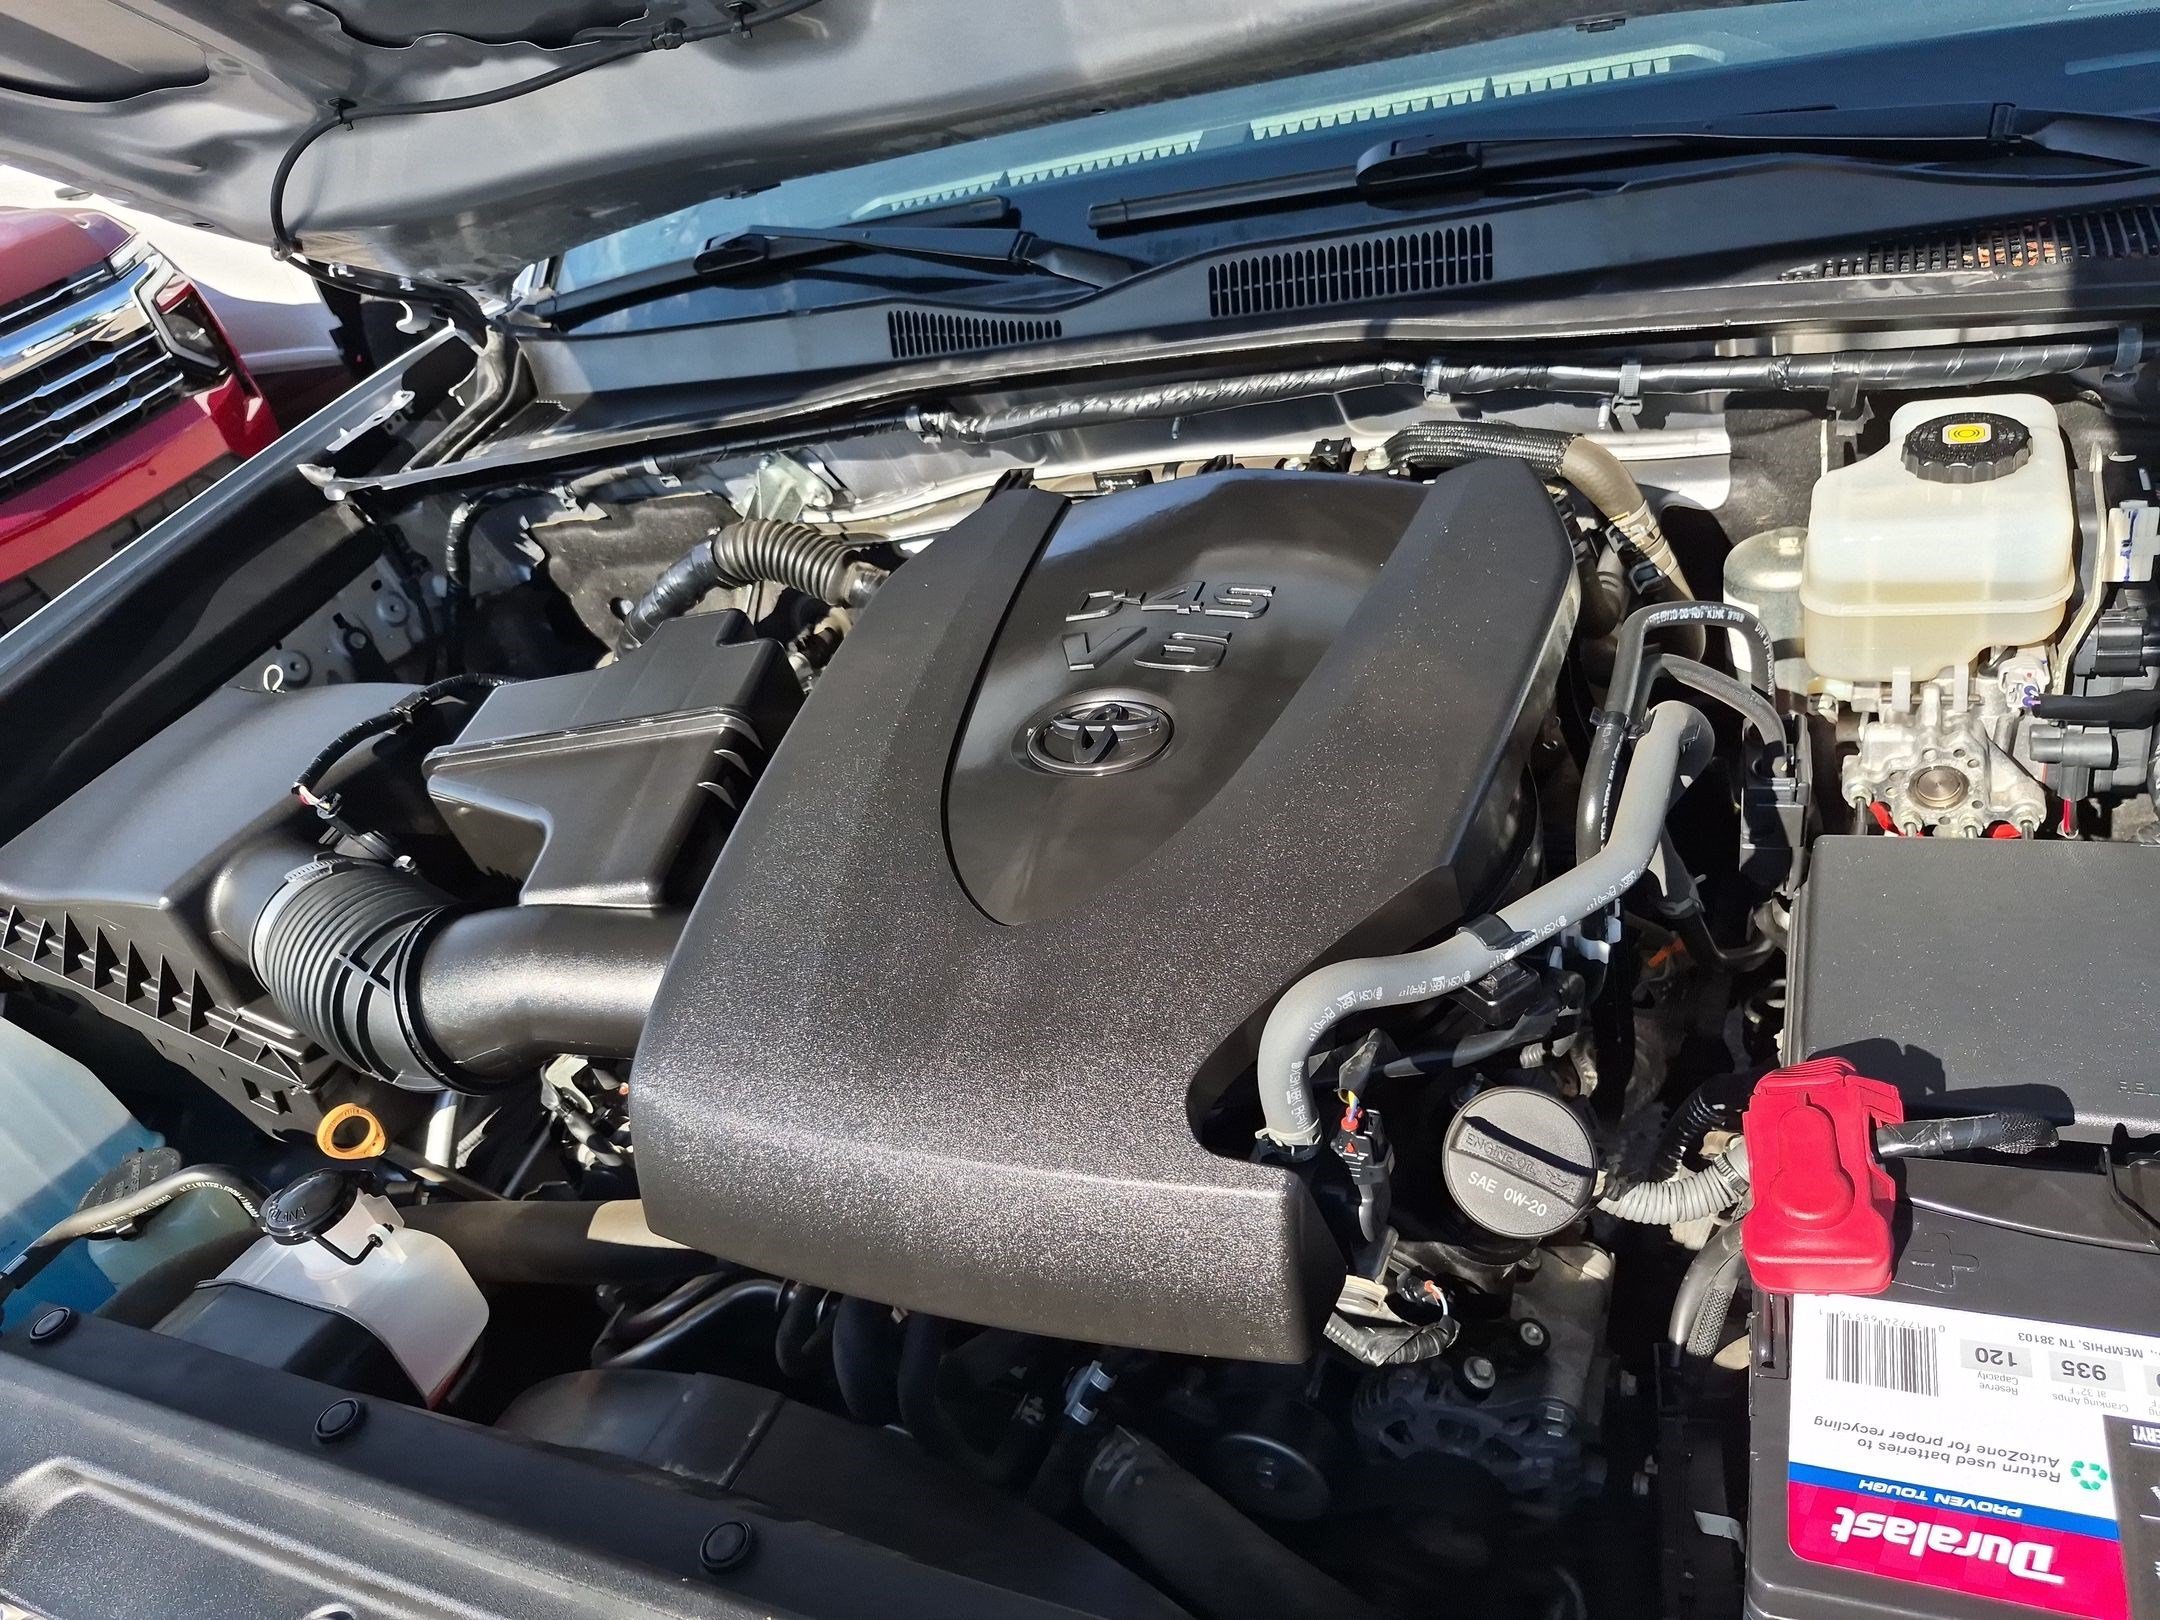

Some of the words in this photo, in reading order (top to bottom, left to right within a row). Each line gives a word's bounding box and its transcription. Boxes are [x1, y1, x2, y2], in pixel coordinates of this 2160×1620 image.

[1465, 1131, 1516, 1167] ENGINE
[1517, 1154, 1538, 1177] OIL
[1467, 1171, 1499, 1194] SAE
[1503, 1187, 1548, 1217] 0W-20
[1839, 1310, 1878, 1323] 68516
[1885, 1317, 1922, 1330] 17724
[2018, 1332, 2055, 1346] 38103
[2059, 1337, 2076, 1349] TN
[2078, 1338, 2144, 1358] MEMPHIS,
[1974, 1347, 2018, 1367] 120
[1977, 1370, 2019, 1385] Capacity
[2060, 1359, 2107, 1381] 935
[1979, 1382, 2019, 1396] Reserve
[2096, 1389, 2107, 1399] at
[2052, 1392, 2081, 1406] Amps
[2083, 1398, 2129, 1413] Cranking
[1813, 1414, 1885, 1438] recycling
[1856, 1438, 1873, 1451] to
[1888, 1430, 1944, 1447] proper
[1947, 1439, 1971, 1452] for
[1877, 1442, 1951, 1464] batteries
[1976, 1445, 2060, 1468] AutoZone
[1955, 1455, 1996, 1469] used
[2002, 1462, 2061, 1484] Return
[1858, 1479, 1929, 1501] TOUGH
[1933, 1492, 2024, 1518] PROVEN
[1830, 1506, 2066, 1585] Duralast
